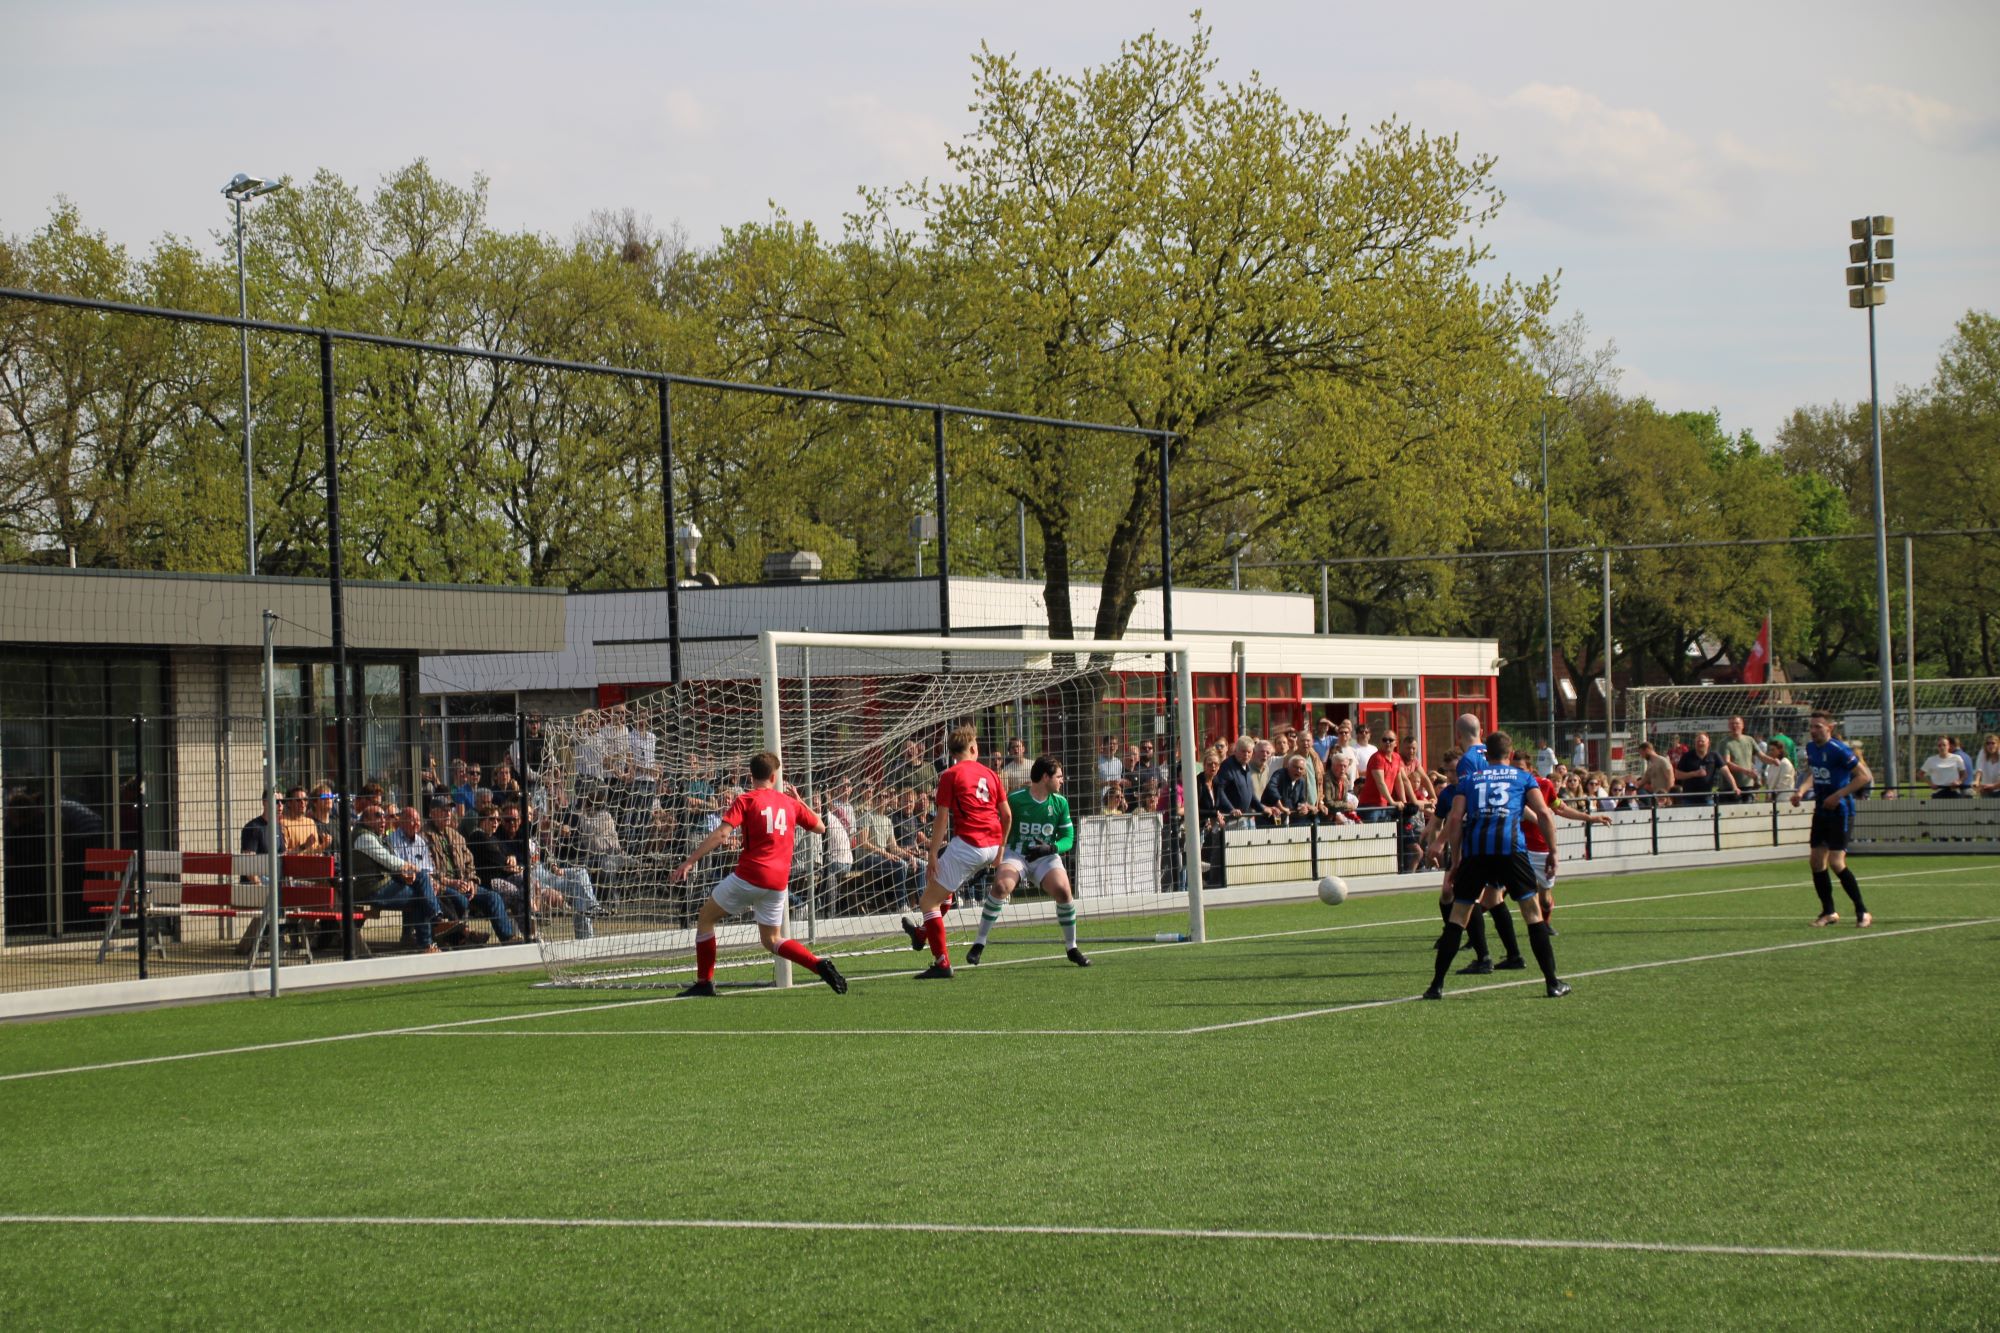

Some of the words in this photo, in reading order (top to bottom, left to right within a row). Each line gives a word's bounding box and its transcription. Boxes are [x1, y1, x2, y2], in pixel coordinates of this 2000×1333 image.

[975, 777, 990, 803] 4
[1474, 781, 1511, 808] 13
[760, 806, 788, 836] 14
[1019, 821, 1054, 836] BBQ
